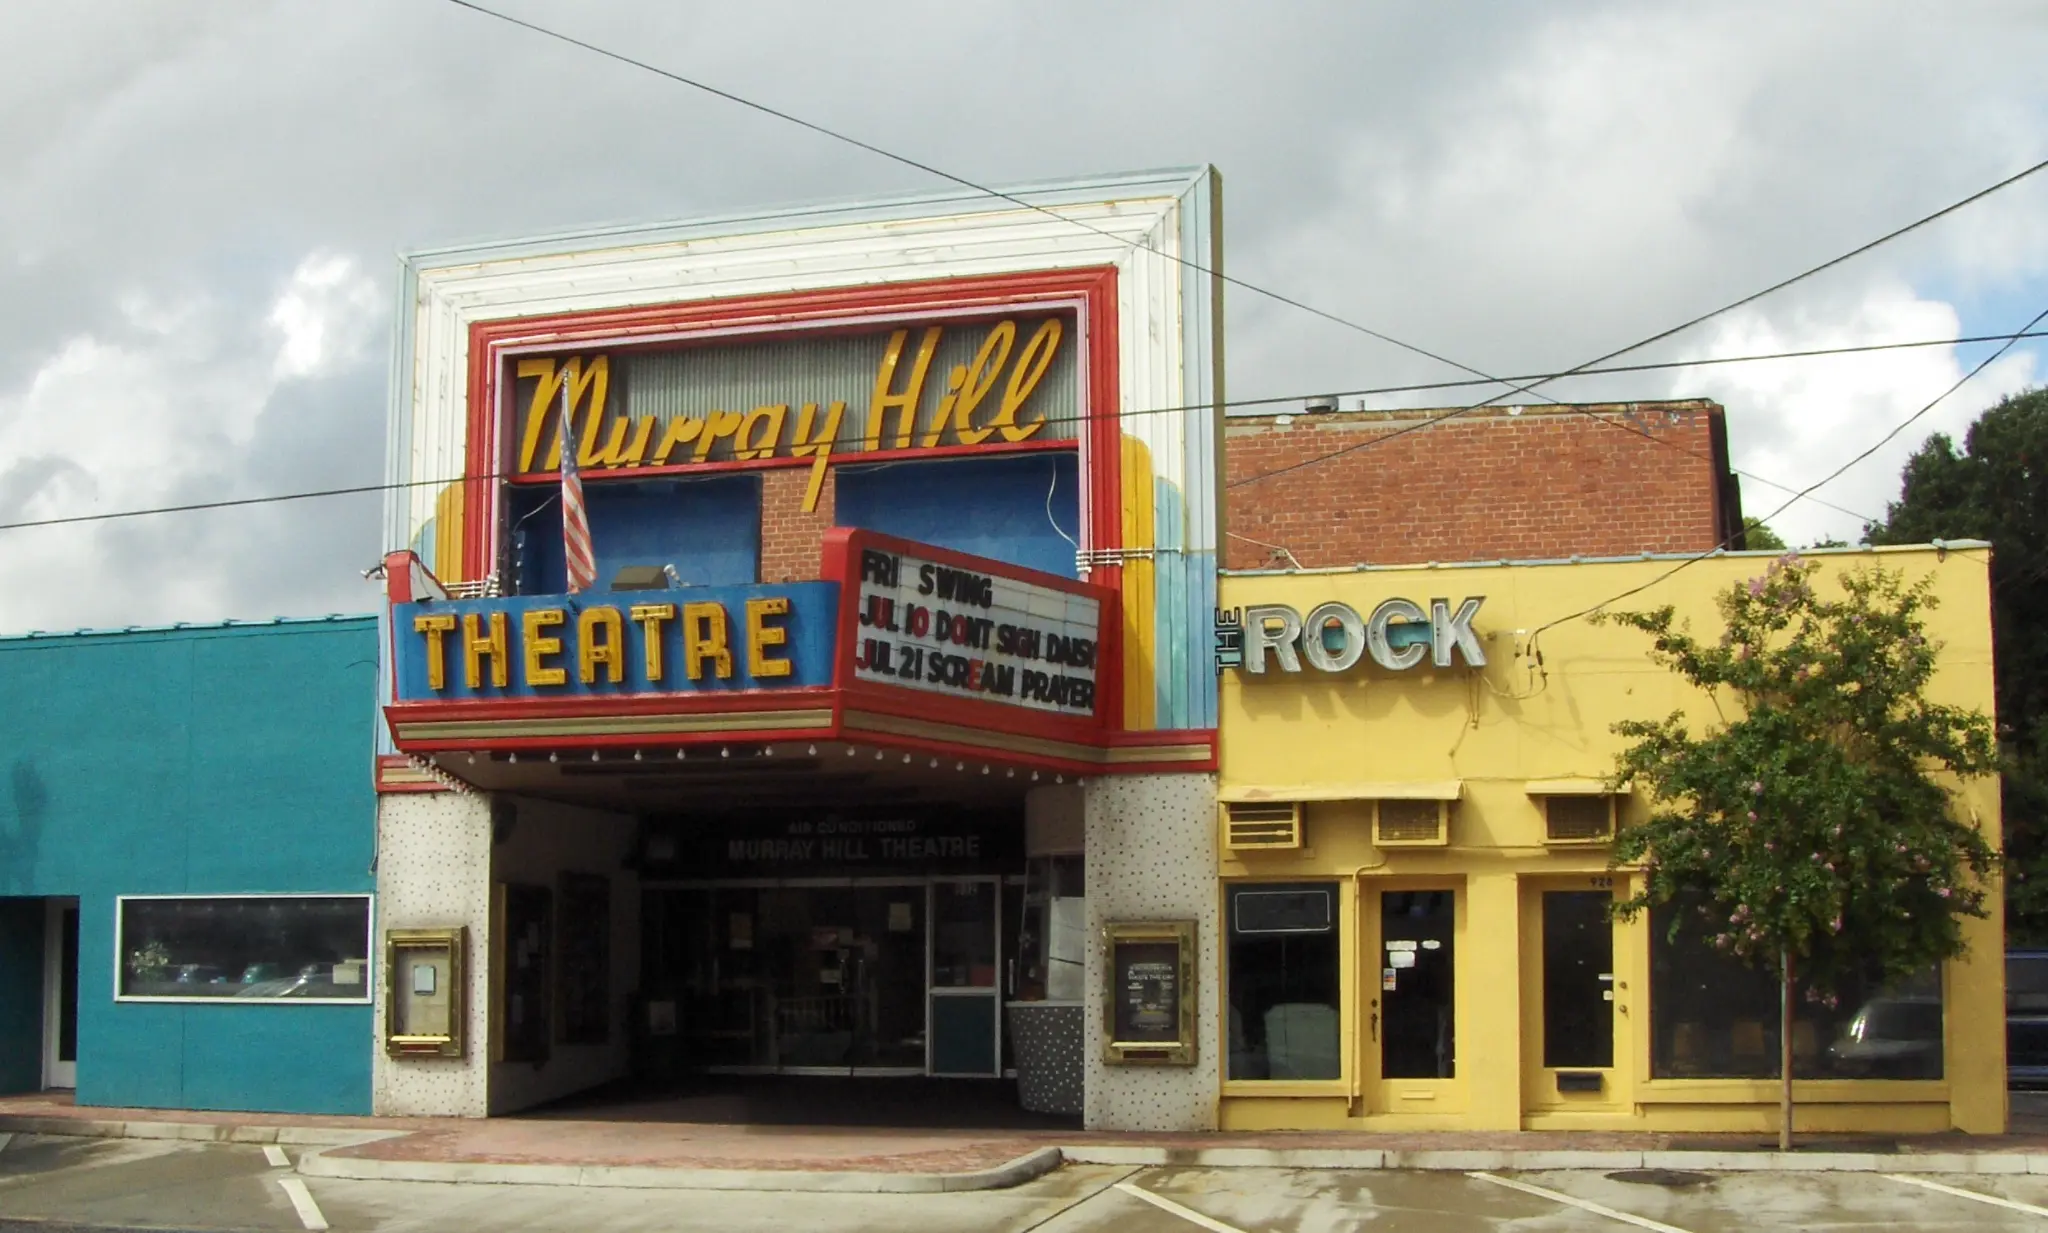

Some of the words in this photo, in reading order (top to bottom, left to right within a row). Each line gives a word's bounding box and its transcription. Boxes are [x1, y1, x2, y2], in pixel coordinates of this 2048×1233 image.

[517, 355, 845, 512] Murray
[862, 318, 1063, 452] Hill
[861, 549, 899, 588] FRI
[918, 564, 993, 609] SWING
[413, 597, 792, 690] THEATRE
[860, 594, 898, 632] JUL
[905, 603, 930, 637] 10
[936, 609, 994, 650] DONT
[997, 623, 1041, 659] SIGH
[1215, 607, 1241, 675] THE
[1245, 596, 1487, 674] ROCK
[855, 638, 896, 676] JUL
[899, 646, 924, 681] 21
[928, 651, 1015, 698] SCREAM
[728, 839, 815, 861] MURRAY
[822, 838, 870, 860] HILL
[881, 836, 981, 858] THEATRE
[788, 821, 812, 834] AIR
